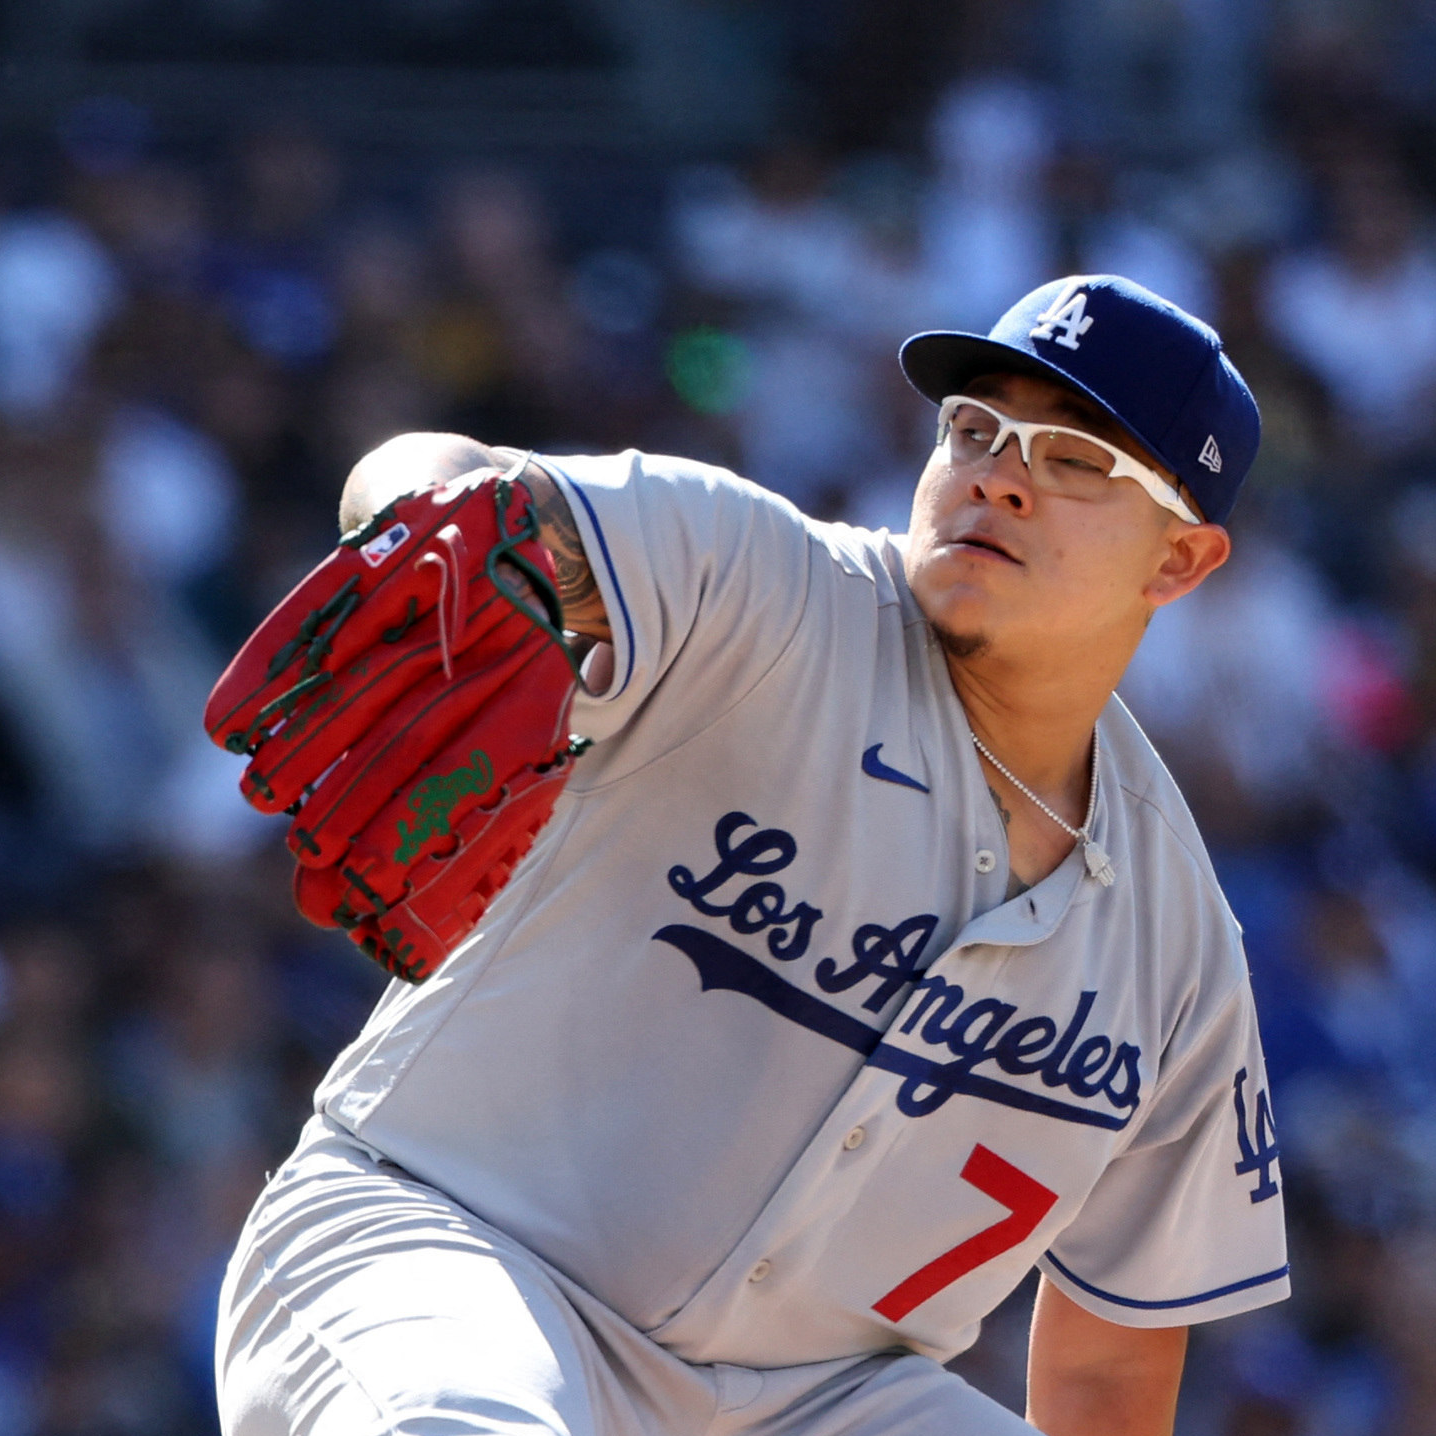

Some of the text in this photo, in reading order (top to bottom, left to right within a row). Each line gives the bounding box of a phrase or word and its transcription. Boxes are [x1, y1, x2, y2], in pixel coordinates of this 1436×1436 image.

[1029, 277, 1094, 350] LA
[667, 811, 1142, 1118] Los Angeles
[871, 1142, 1059, 1323] 7
